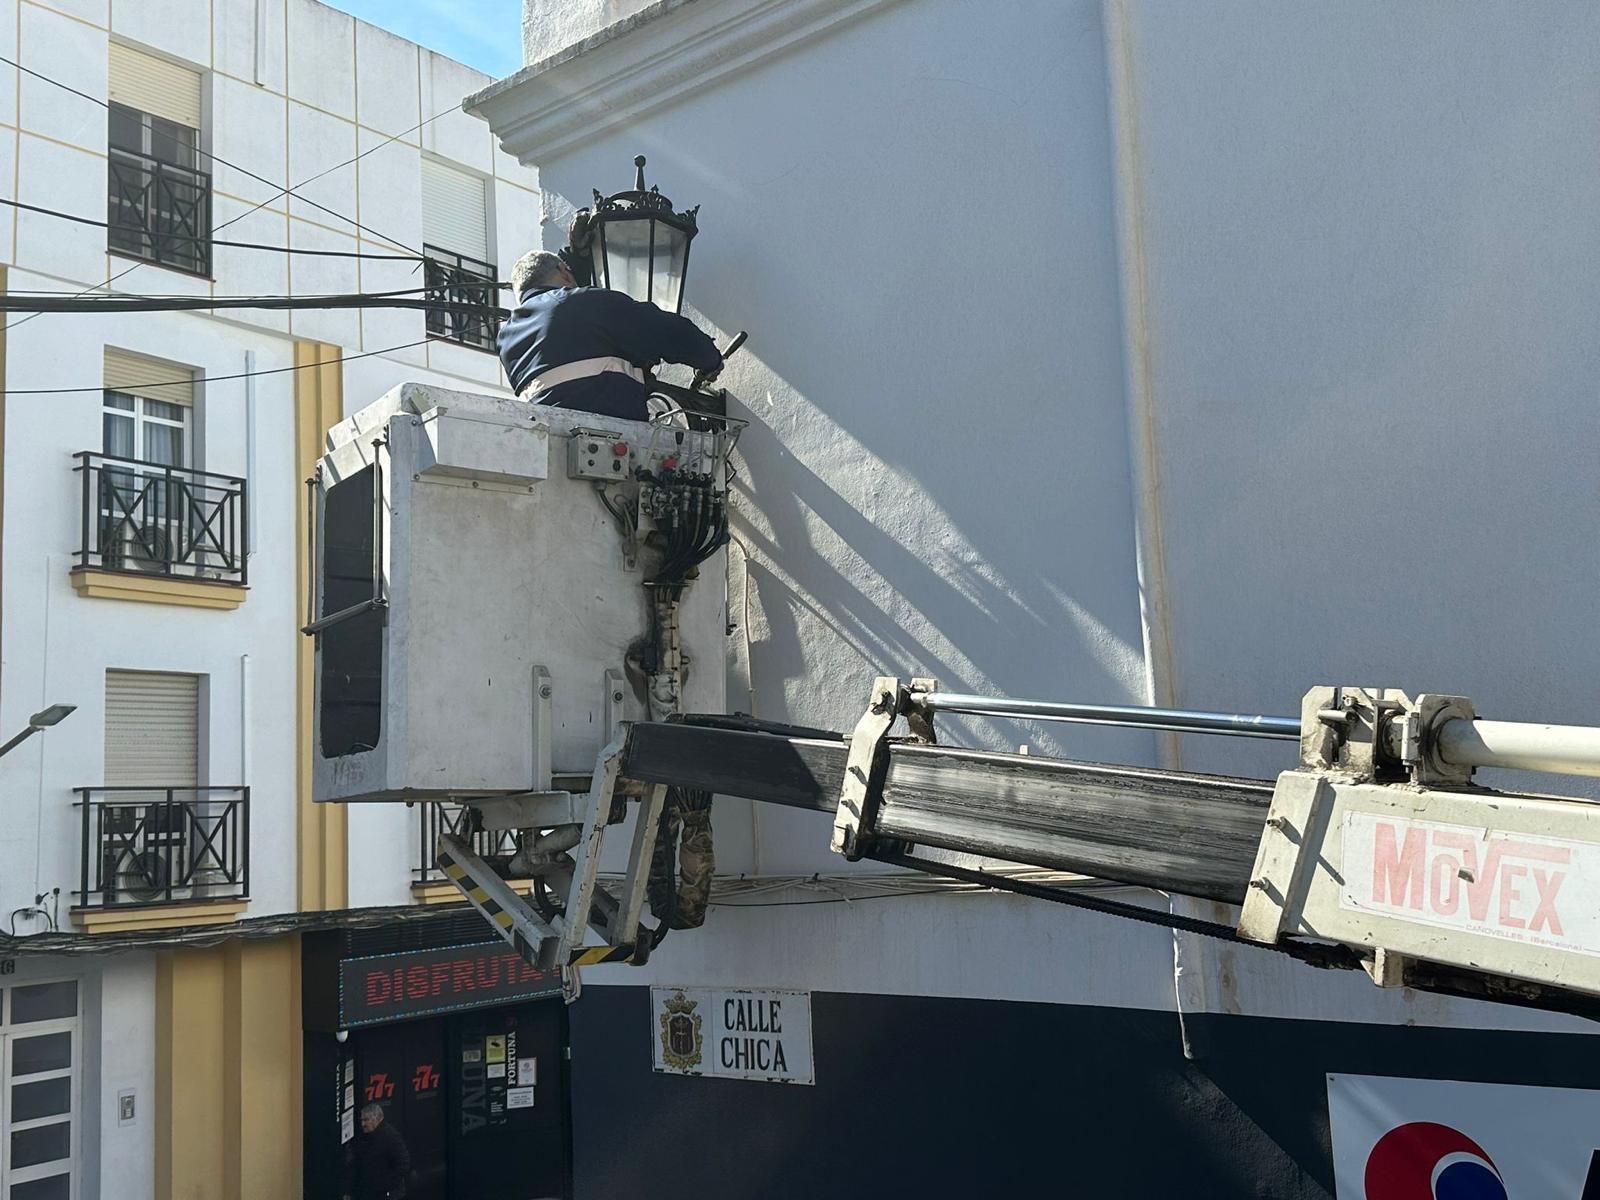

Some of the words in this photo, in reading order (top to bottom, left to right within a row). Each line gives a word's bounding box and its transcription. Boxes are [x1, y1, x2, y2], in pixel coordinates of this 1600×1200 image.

[1372, 823, 1570, 936] MOVEX
[724, 999, 782, 1033] CALLE
[508, 1031, 516, 1086] FORTUNA
[721, 1037, 788, 1072] CHICA
